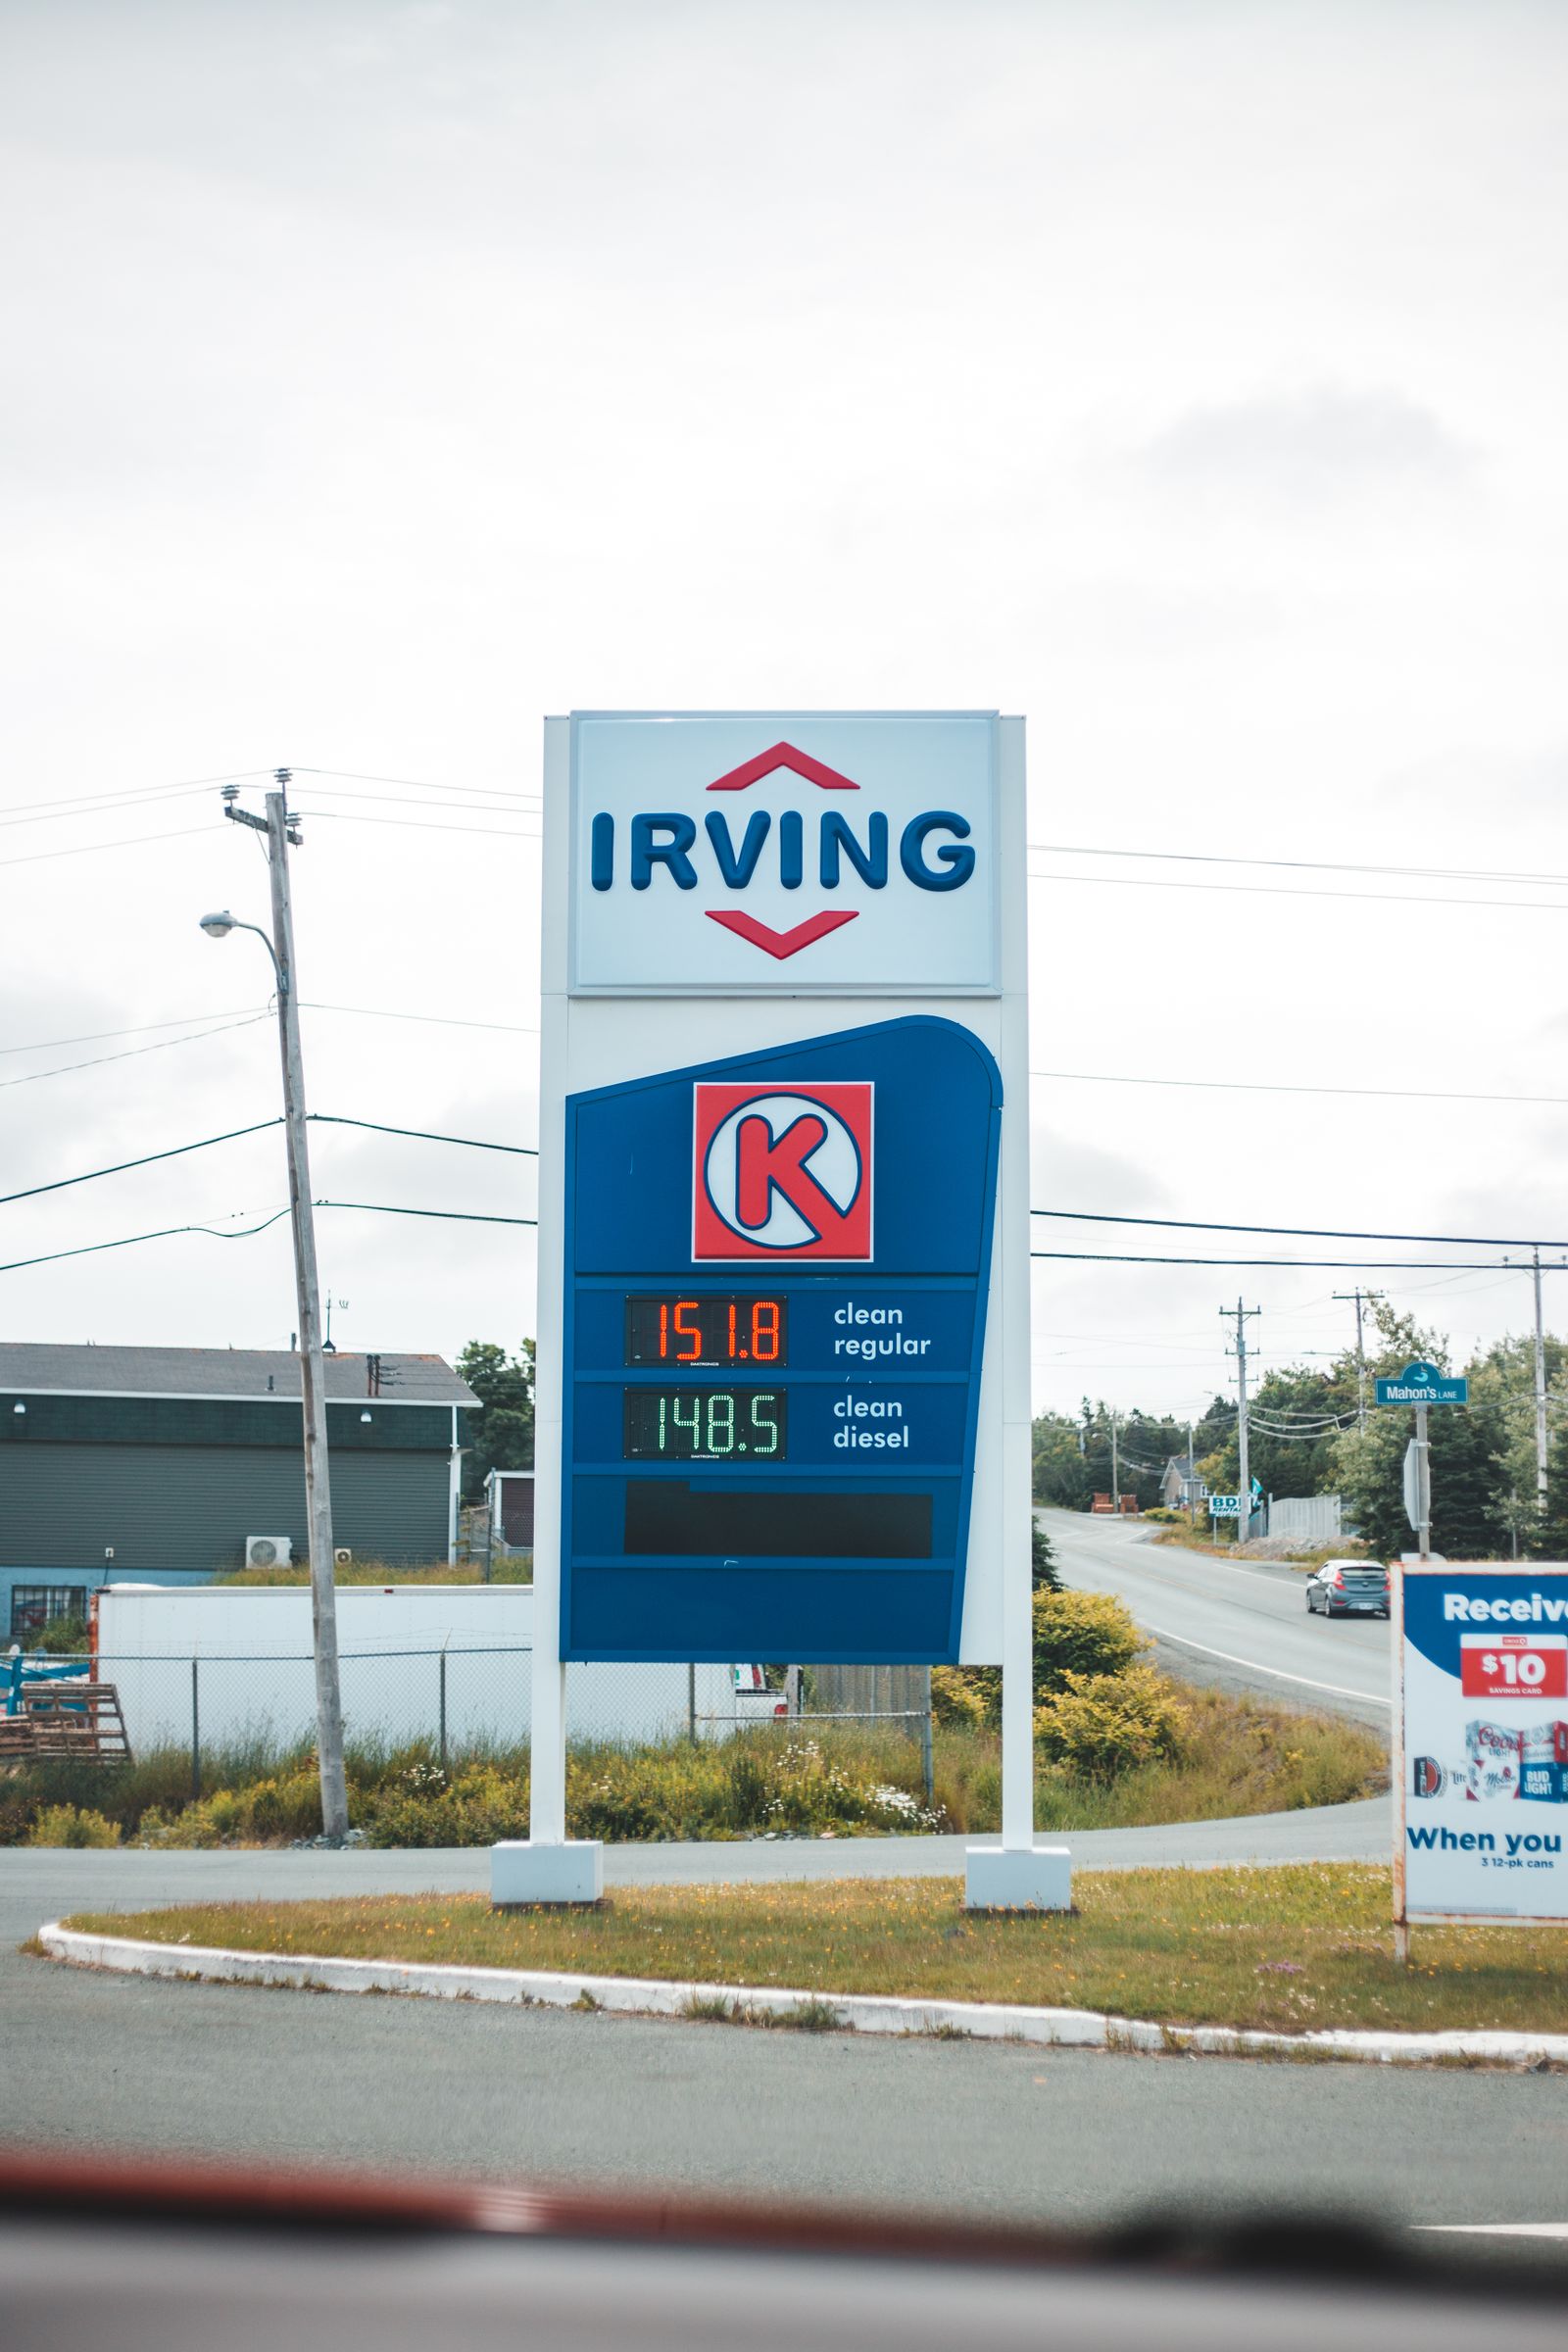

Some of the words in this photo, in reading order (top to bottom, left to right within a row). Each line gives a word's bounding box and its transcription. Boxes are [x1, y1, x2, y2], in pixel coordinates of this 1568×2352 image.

[591, 810, 976, 892] IRVING
[735, 1113, 845, 1239] K
[834, 1301, 903, 1325] clean
[660, 1301, 779, 1360] 151.8
[835, 1332, 931, 1360] regular
[833, 1395, 903, 1417] clean
[1387, 1386, 1437, 1399] Mahon's
[1438, 1391, 1457, 1399] LANE
[659, 1395, 777, 1452] 148.5
[833, 1425, 908, 1448] diesel
[1444, 1593, 1568, 1622] Receiv
[1482, 1654, 1545, 1685] $10
[1524, 1781, 1552, 1795] LIGHT
[1526, 1770, 1550, 1783] BUD
[1406, 1827, 1494, 1851] When
[1505, 1834, 1561, 1856] you
[1482, 1858, 1489, 1867] 3
[1493, 1858, 1523, 1869] 12-pk
[1527, 1859, 1554, 1868] cans
